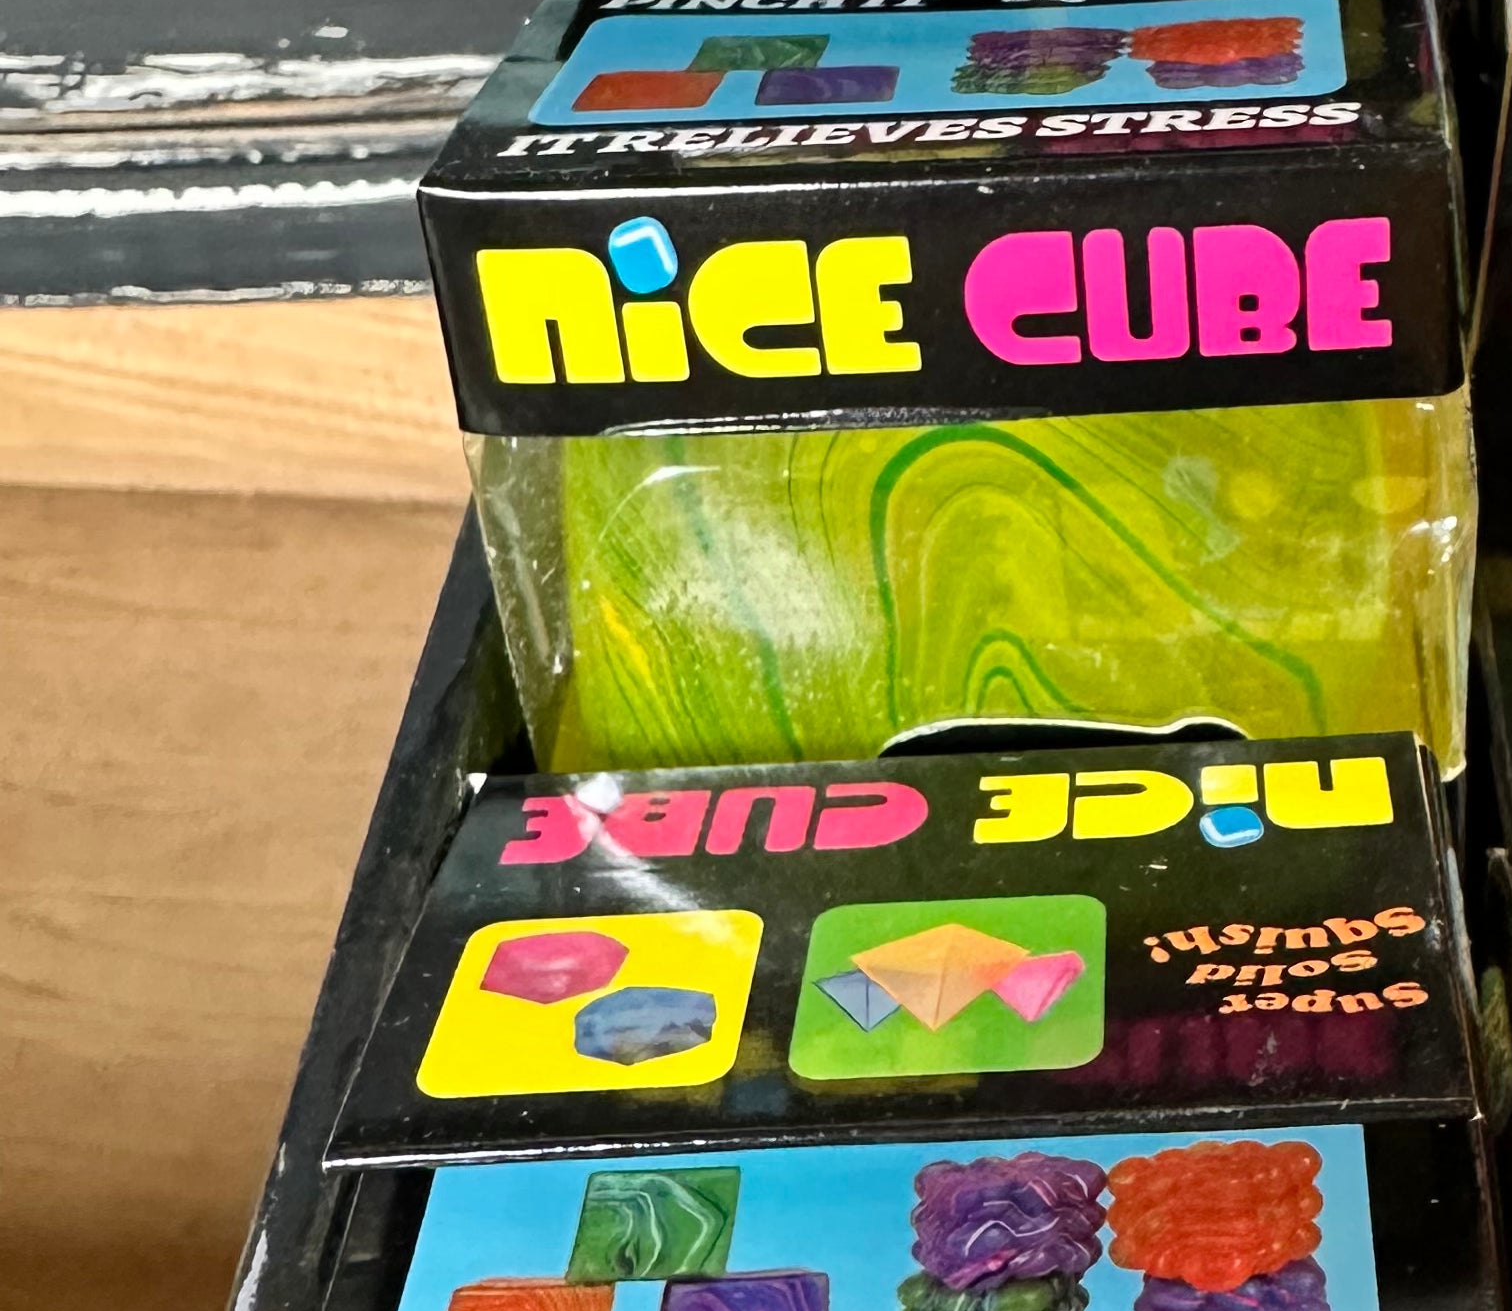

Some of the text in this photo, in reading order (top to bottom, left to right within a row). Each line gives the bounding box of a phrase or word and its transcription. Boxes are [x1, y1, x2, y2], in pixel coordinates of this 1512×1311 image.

[496, 101, 1363, 158] IT RELIEVES STRESS
[964, 216, 1394, 366] CUBE
[499, 781, 929, 865] CUBE
[1142, 906, 1427, 964] Squish!
[1185, 949, 1379, 987] Solid
[1218, 981, 1429, 1014] Super
